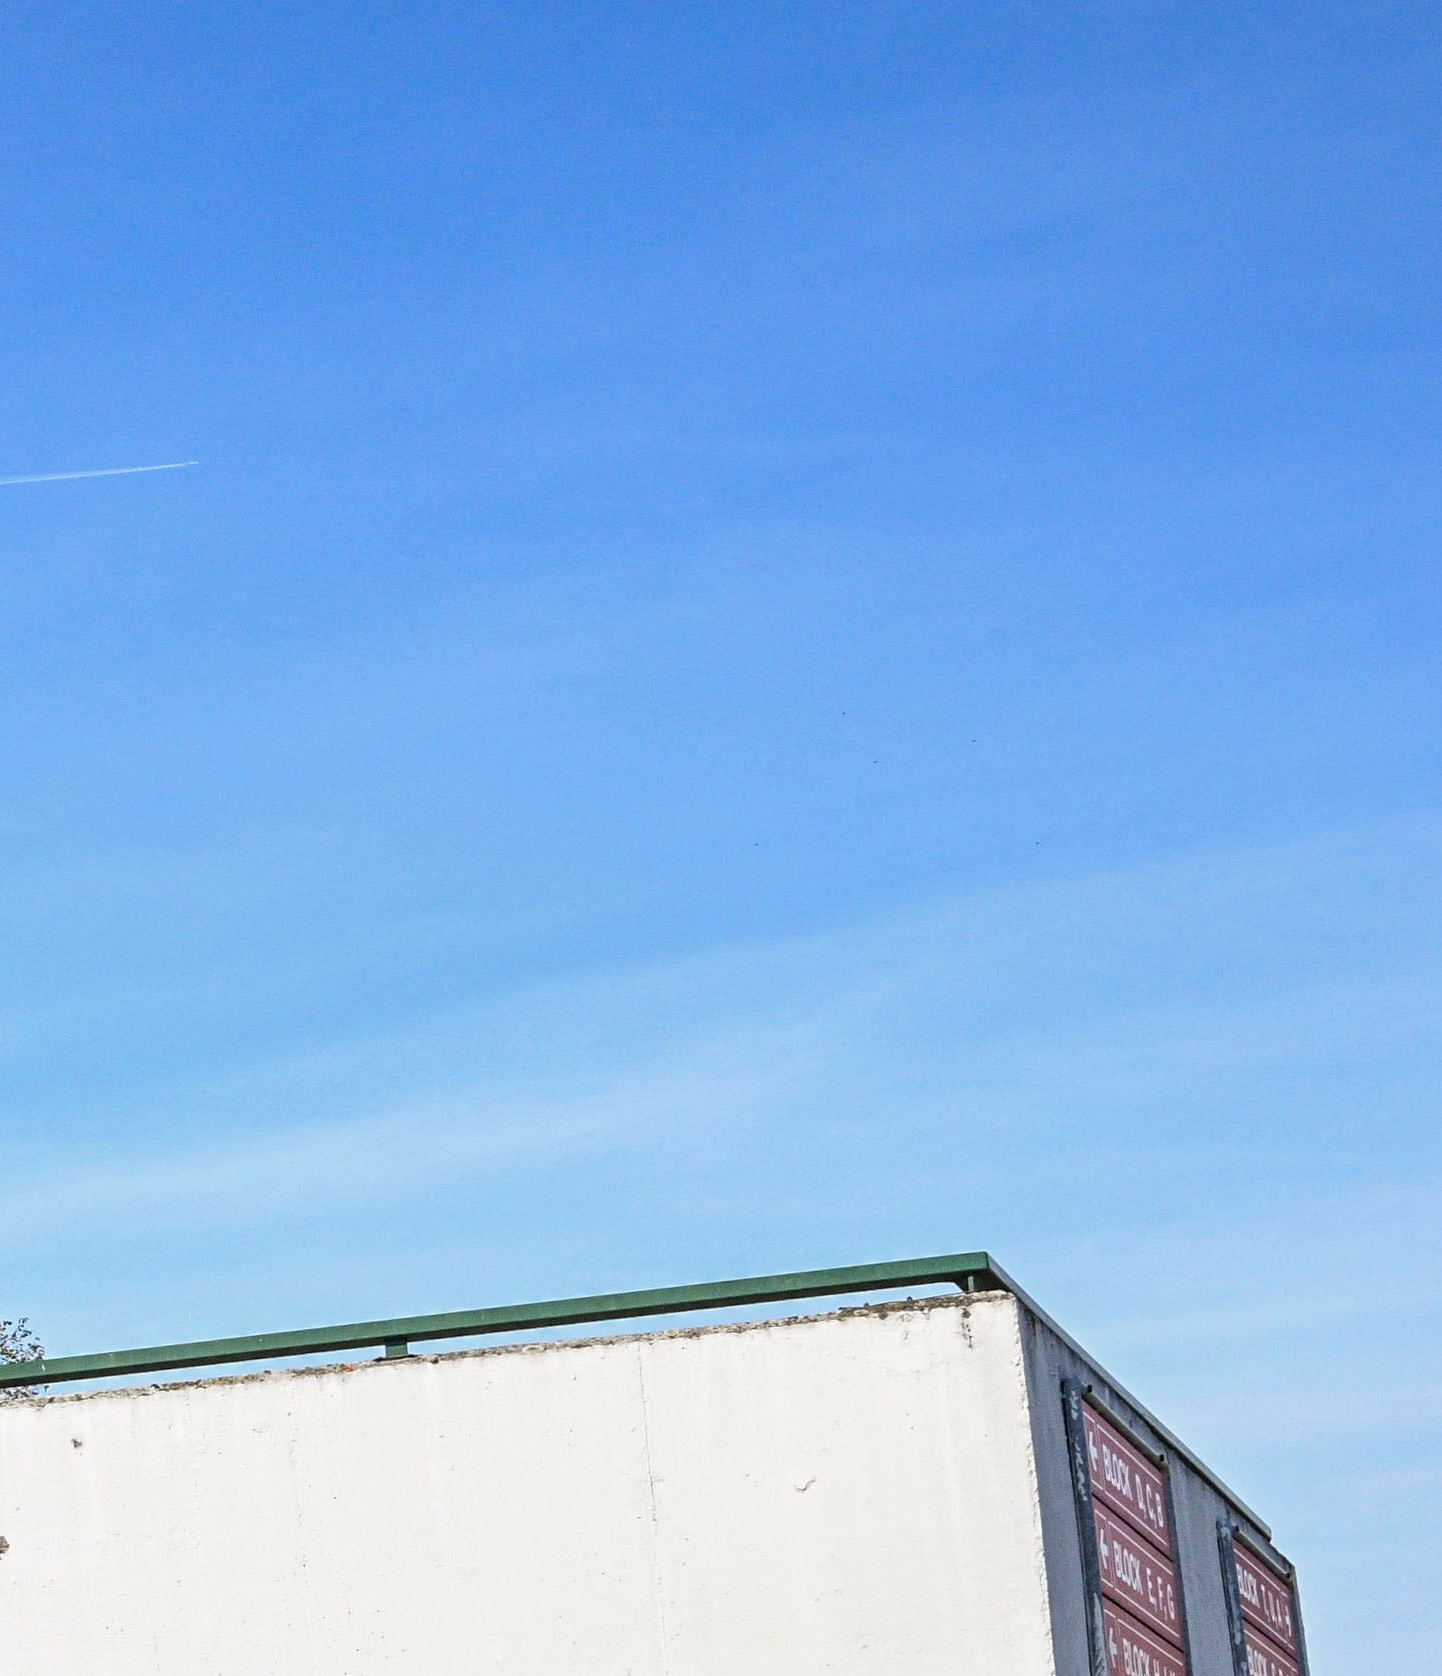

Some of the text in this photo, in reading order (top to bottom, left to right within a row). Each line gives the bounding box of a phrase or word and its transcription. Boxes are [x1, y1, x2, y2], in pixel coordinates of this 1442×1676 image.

[1102, 1444, 1133, 1500] BLOCK
[1113, 1540, 1143, 1594] BLOCK
[1236, 1563, 1260, 1608] BLOCK
